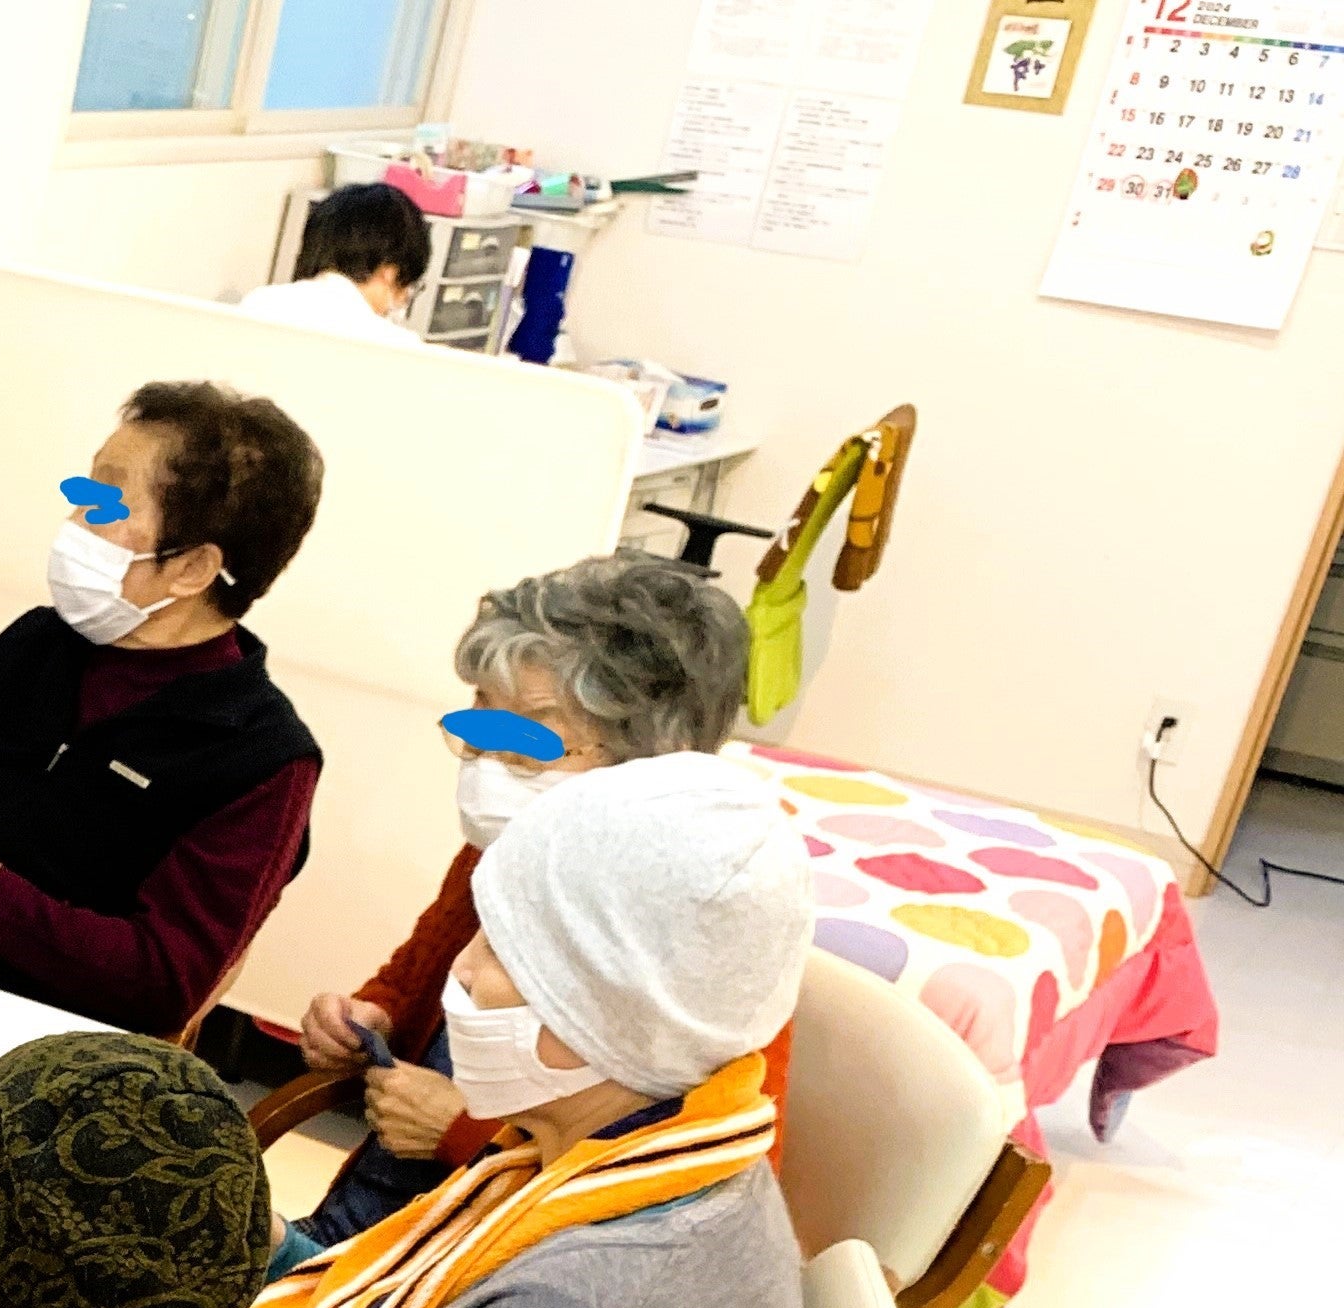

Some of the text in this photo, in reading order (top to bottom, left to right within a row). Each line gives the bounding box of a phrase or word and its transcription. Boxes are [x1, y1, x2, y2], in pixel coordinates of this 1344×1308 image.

[1155, 0, 1192, 22] 12
[1193, 14, 1259, 29] DECEMBER
[1143, 37, 1150, 49] 1
[1169, 40, 1181, 53] 2
[1199, 43, 1210, 56] 3
[1229, 46, 1240, 59] 4
[1258, 49, 1270, 62] 5
[1288, 52, 1299, 65] 6
[1319, 56, 1330, 68] 7
[1129, 72, 1324, 105] 8 9 10 11 12 13 14
[1120, 108, 1311, 143] 15 16 17 18 19 20 21
[1107, 143, 1301, 179] 22 23 24 25 26 27 28
[1096, 178, 1172, 199] 29 30 31
